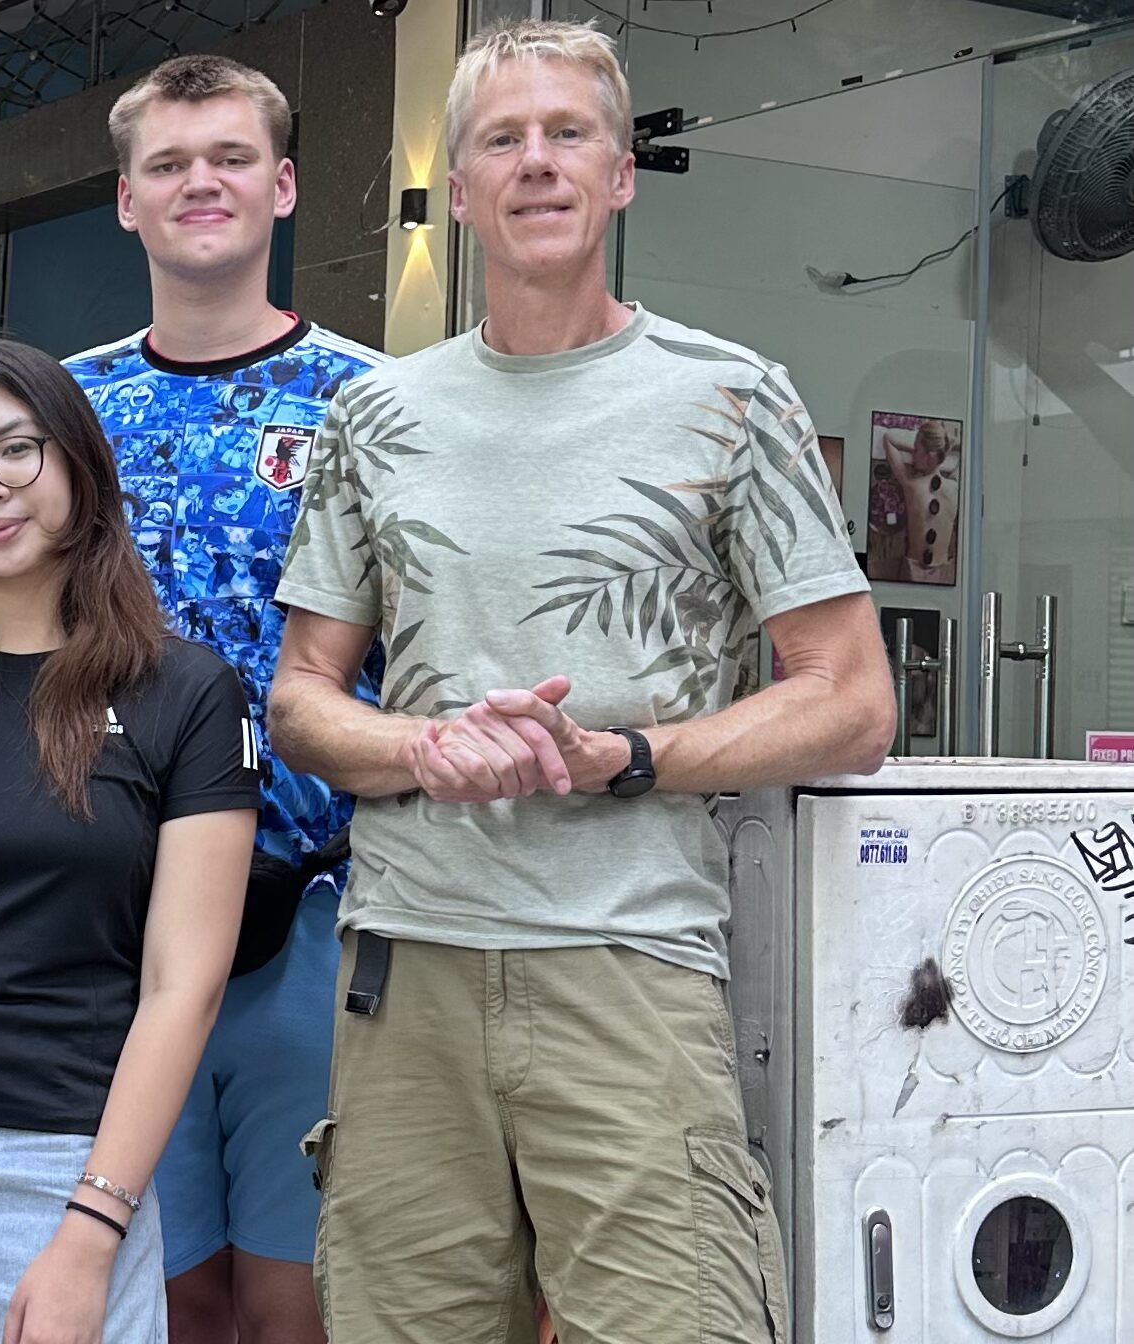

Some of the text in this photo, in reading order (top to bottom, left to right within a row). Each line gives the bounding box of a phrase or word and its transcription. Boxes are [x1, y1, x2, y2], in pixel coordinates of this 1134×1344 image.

[275, 427, 304, 435] JAPAN
[268, 469, 293, 480] JFA
[1092, 749, 1134, 763] FIXED PR
